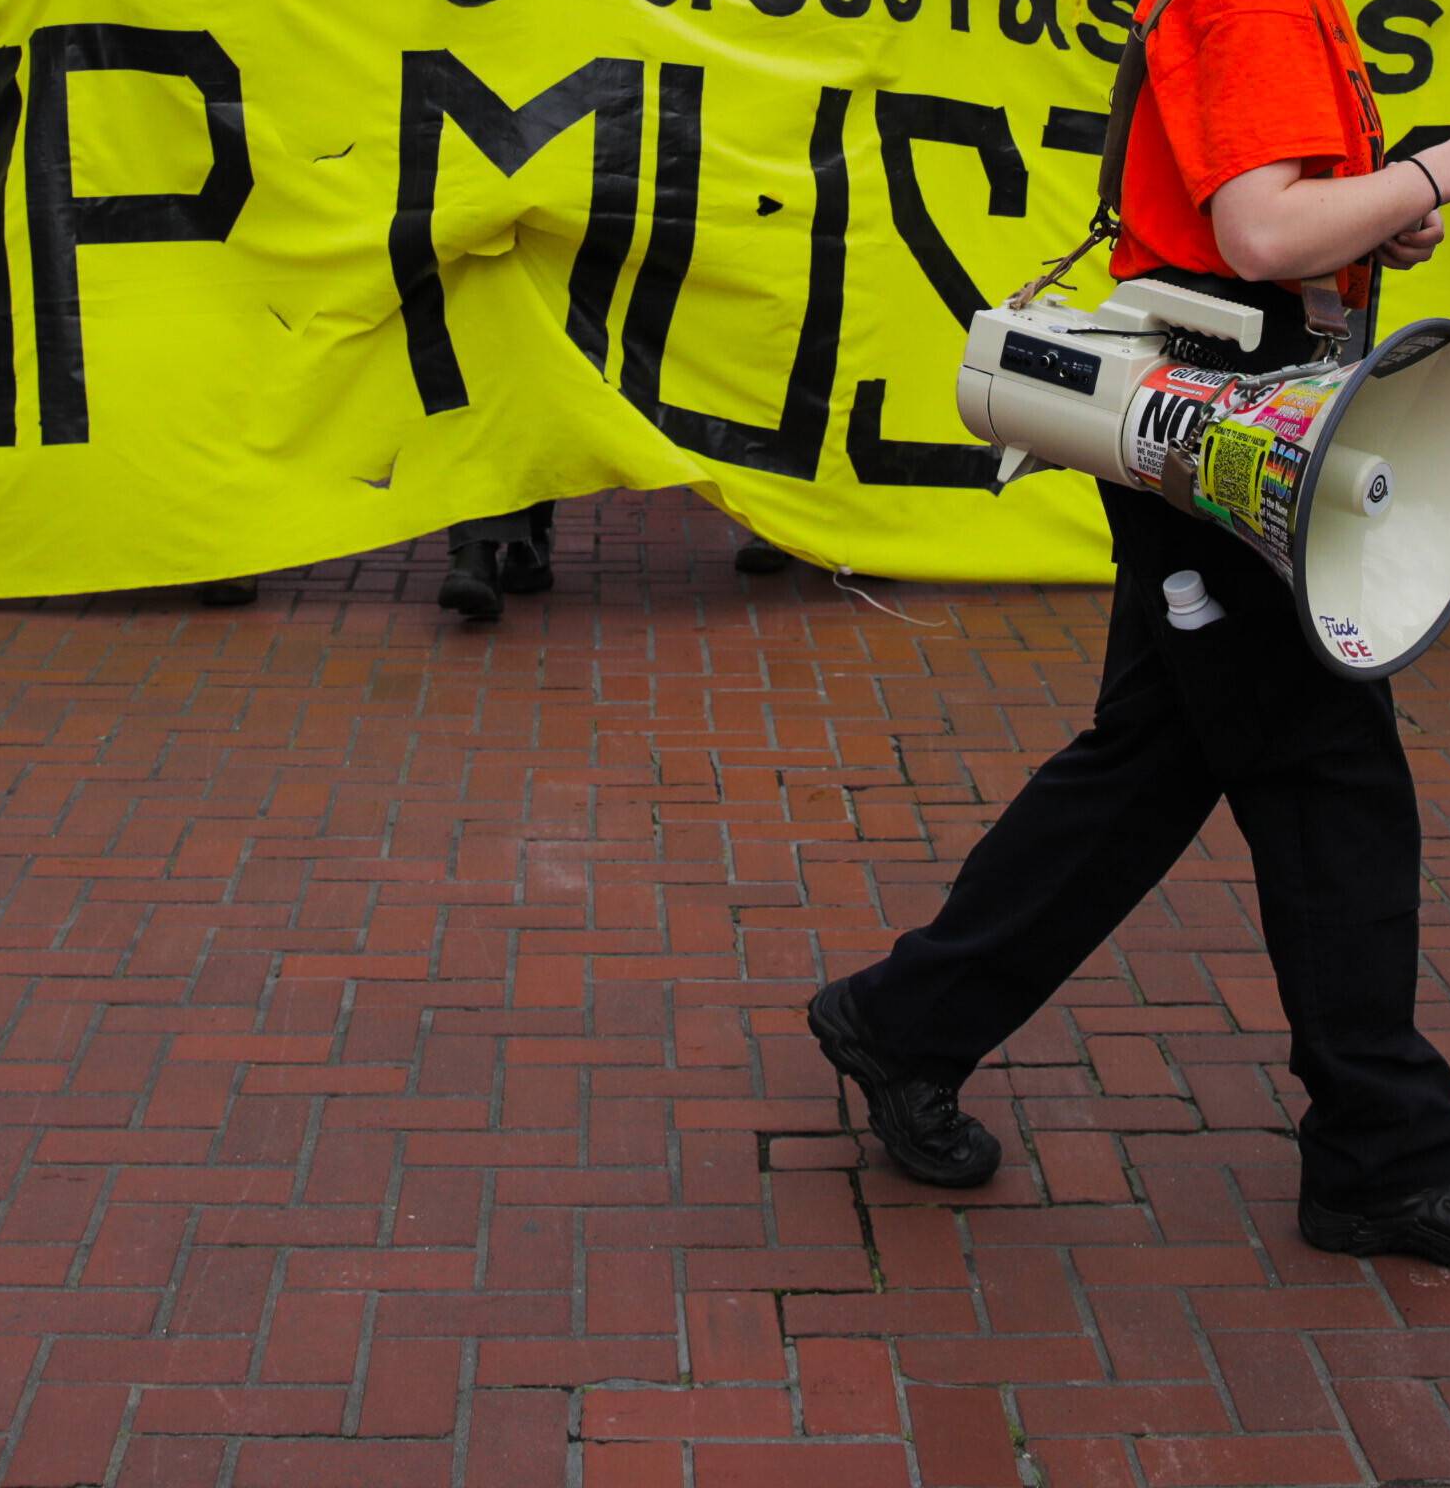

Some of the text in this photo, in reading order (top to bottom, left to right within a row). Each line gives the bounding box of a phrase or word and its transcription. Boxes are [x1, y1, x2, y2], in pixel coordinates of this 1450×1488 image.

[1138, 390, 1209, 454] NO
[1147, 450, 1166, 461] REFUS
[1319, 615, 1359, 638] Fuck
[1336, 639, 1372, 658] ICE
